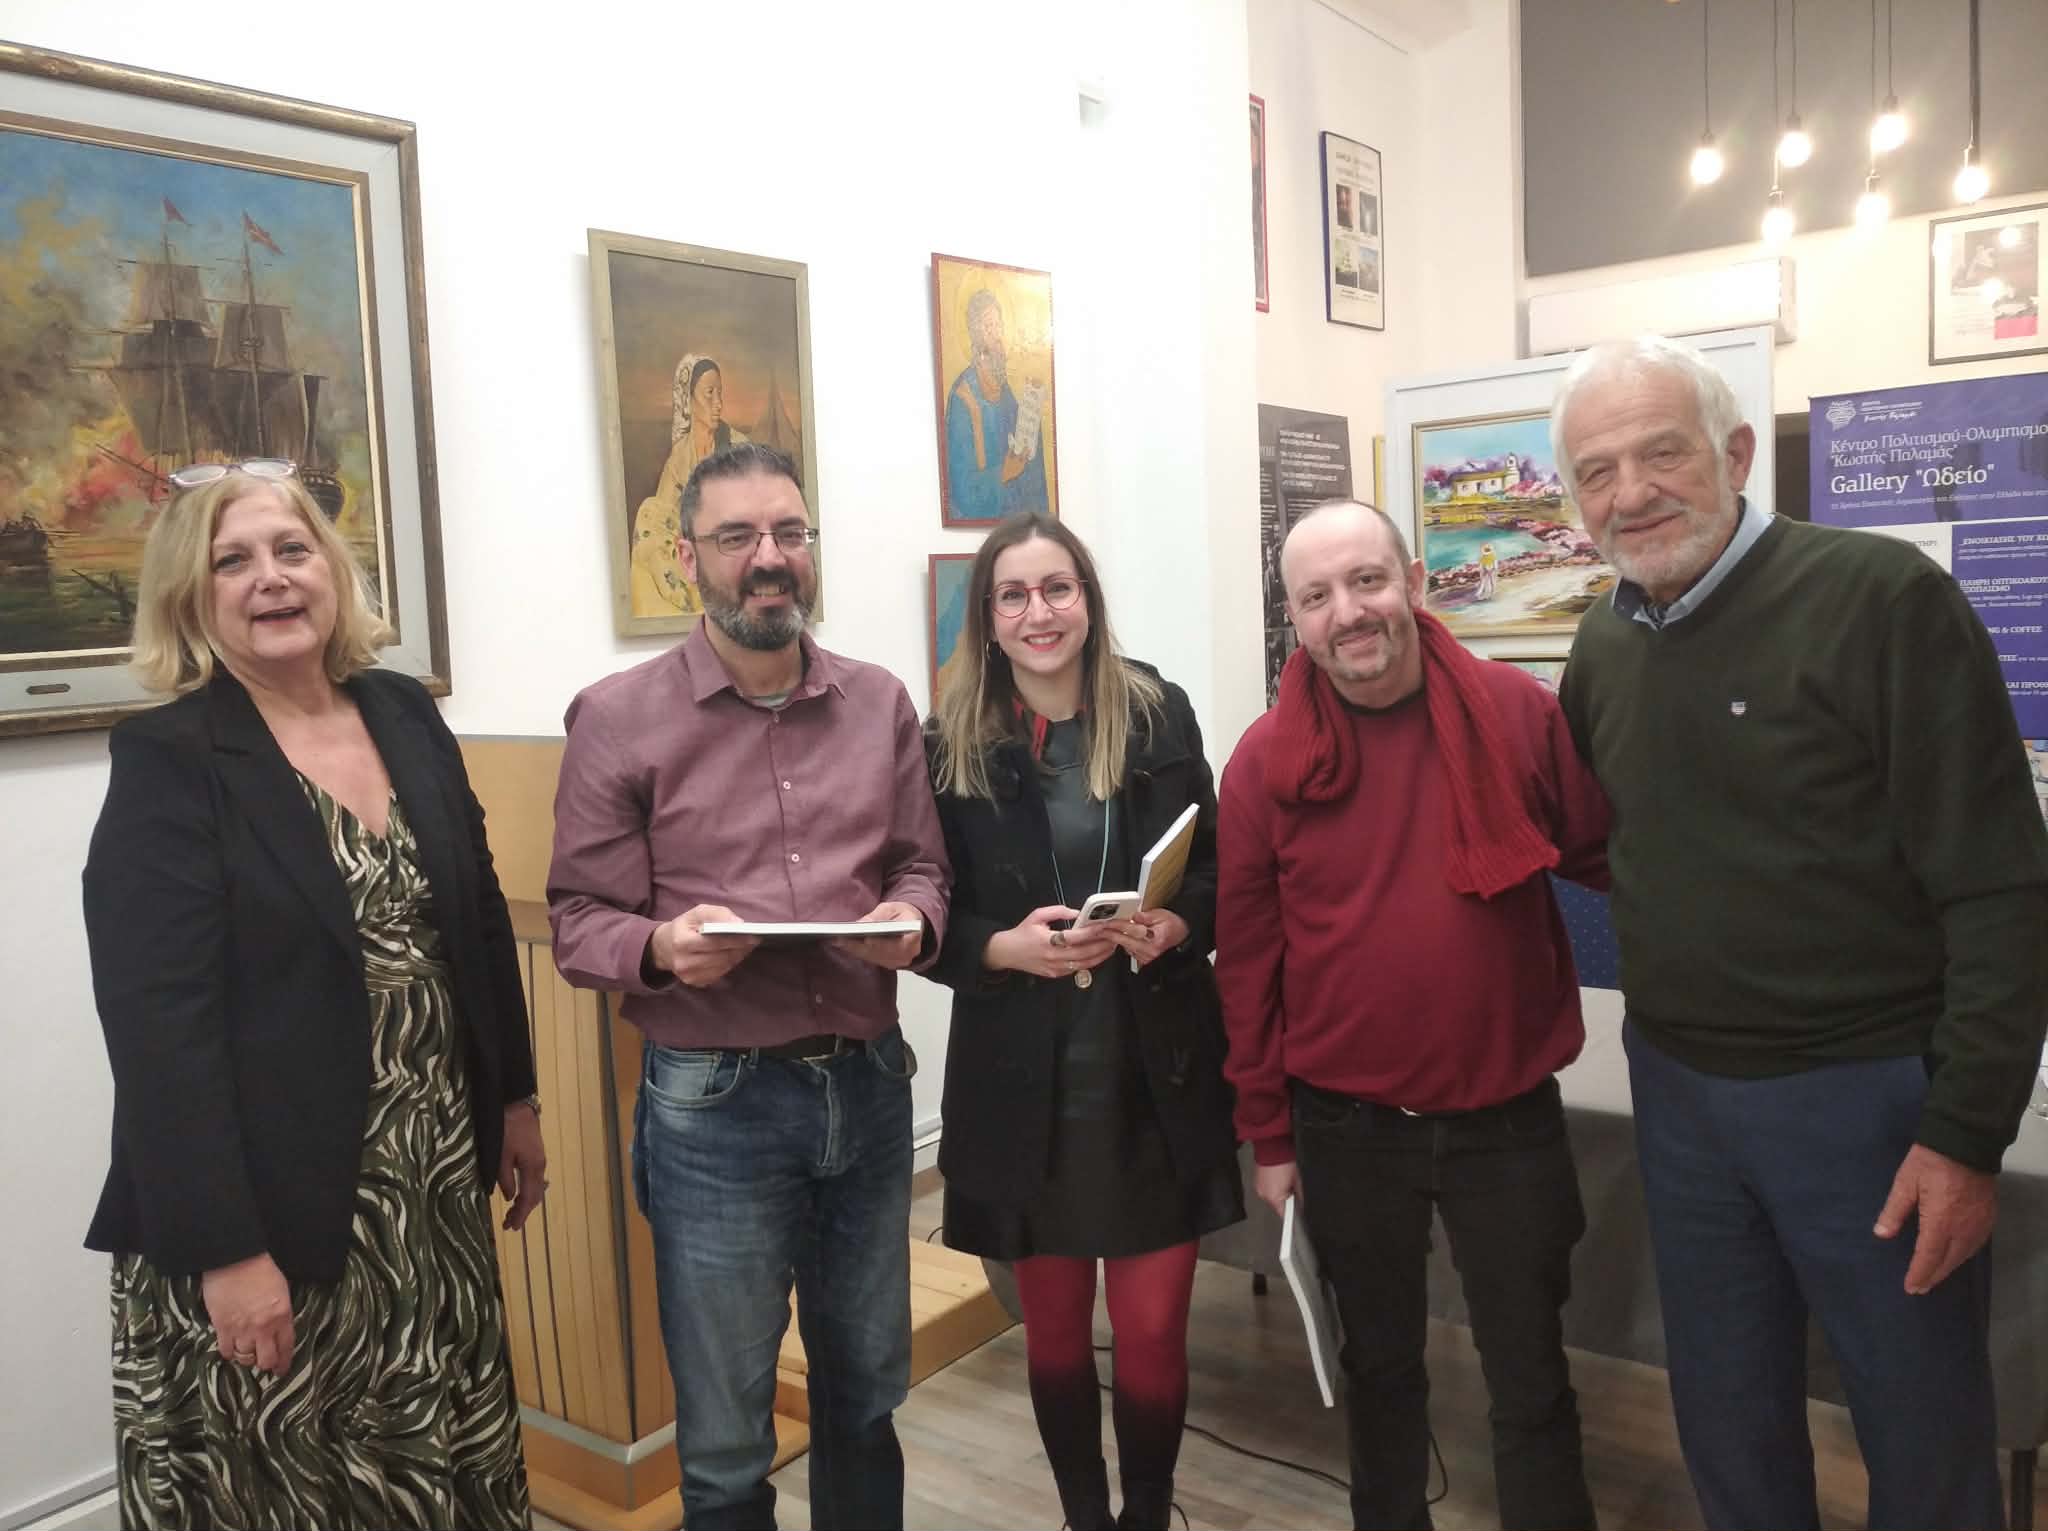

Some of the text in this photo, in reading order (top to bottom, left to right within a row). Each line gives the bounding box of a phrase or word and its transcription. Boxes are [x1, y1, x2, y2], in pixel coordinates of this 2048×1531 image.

[1831, 439, 1879, 453] Κέντρο
[1831, 463, 1996, 494] Gallery "Ωδείο"
